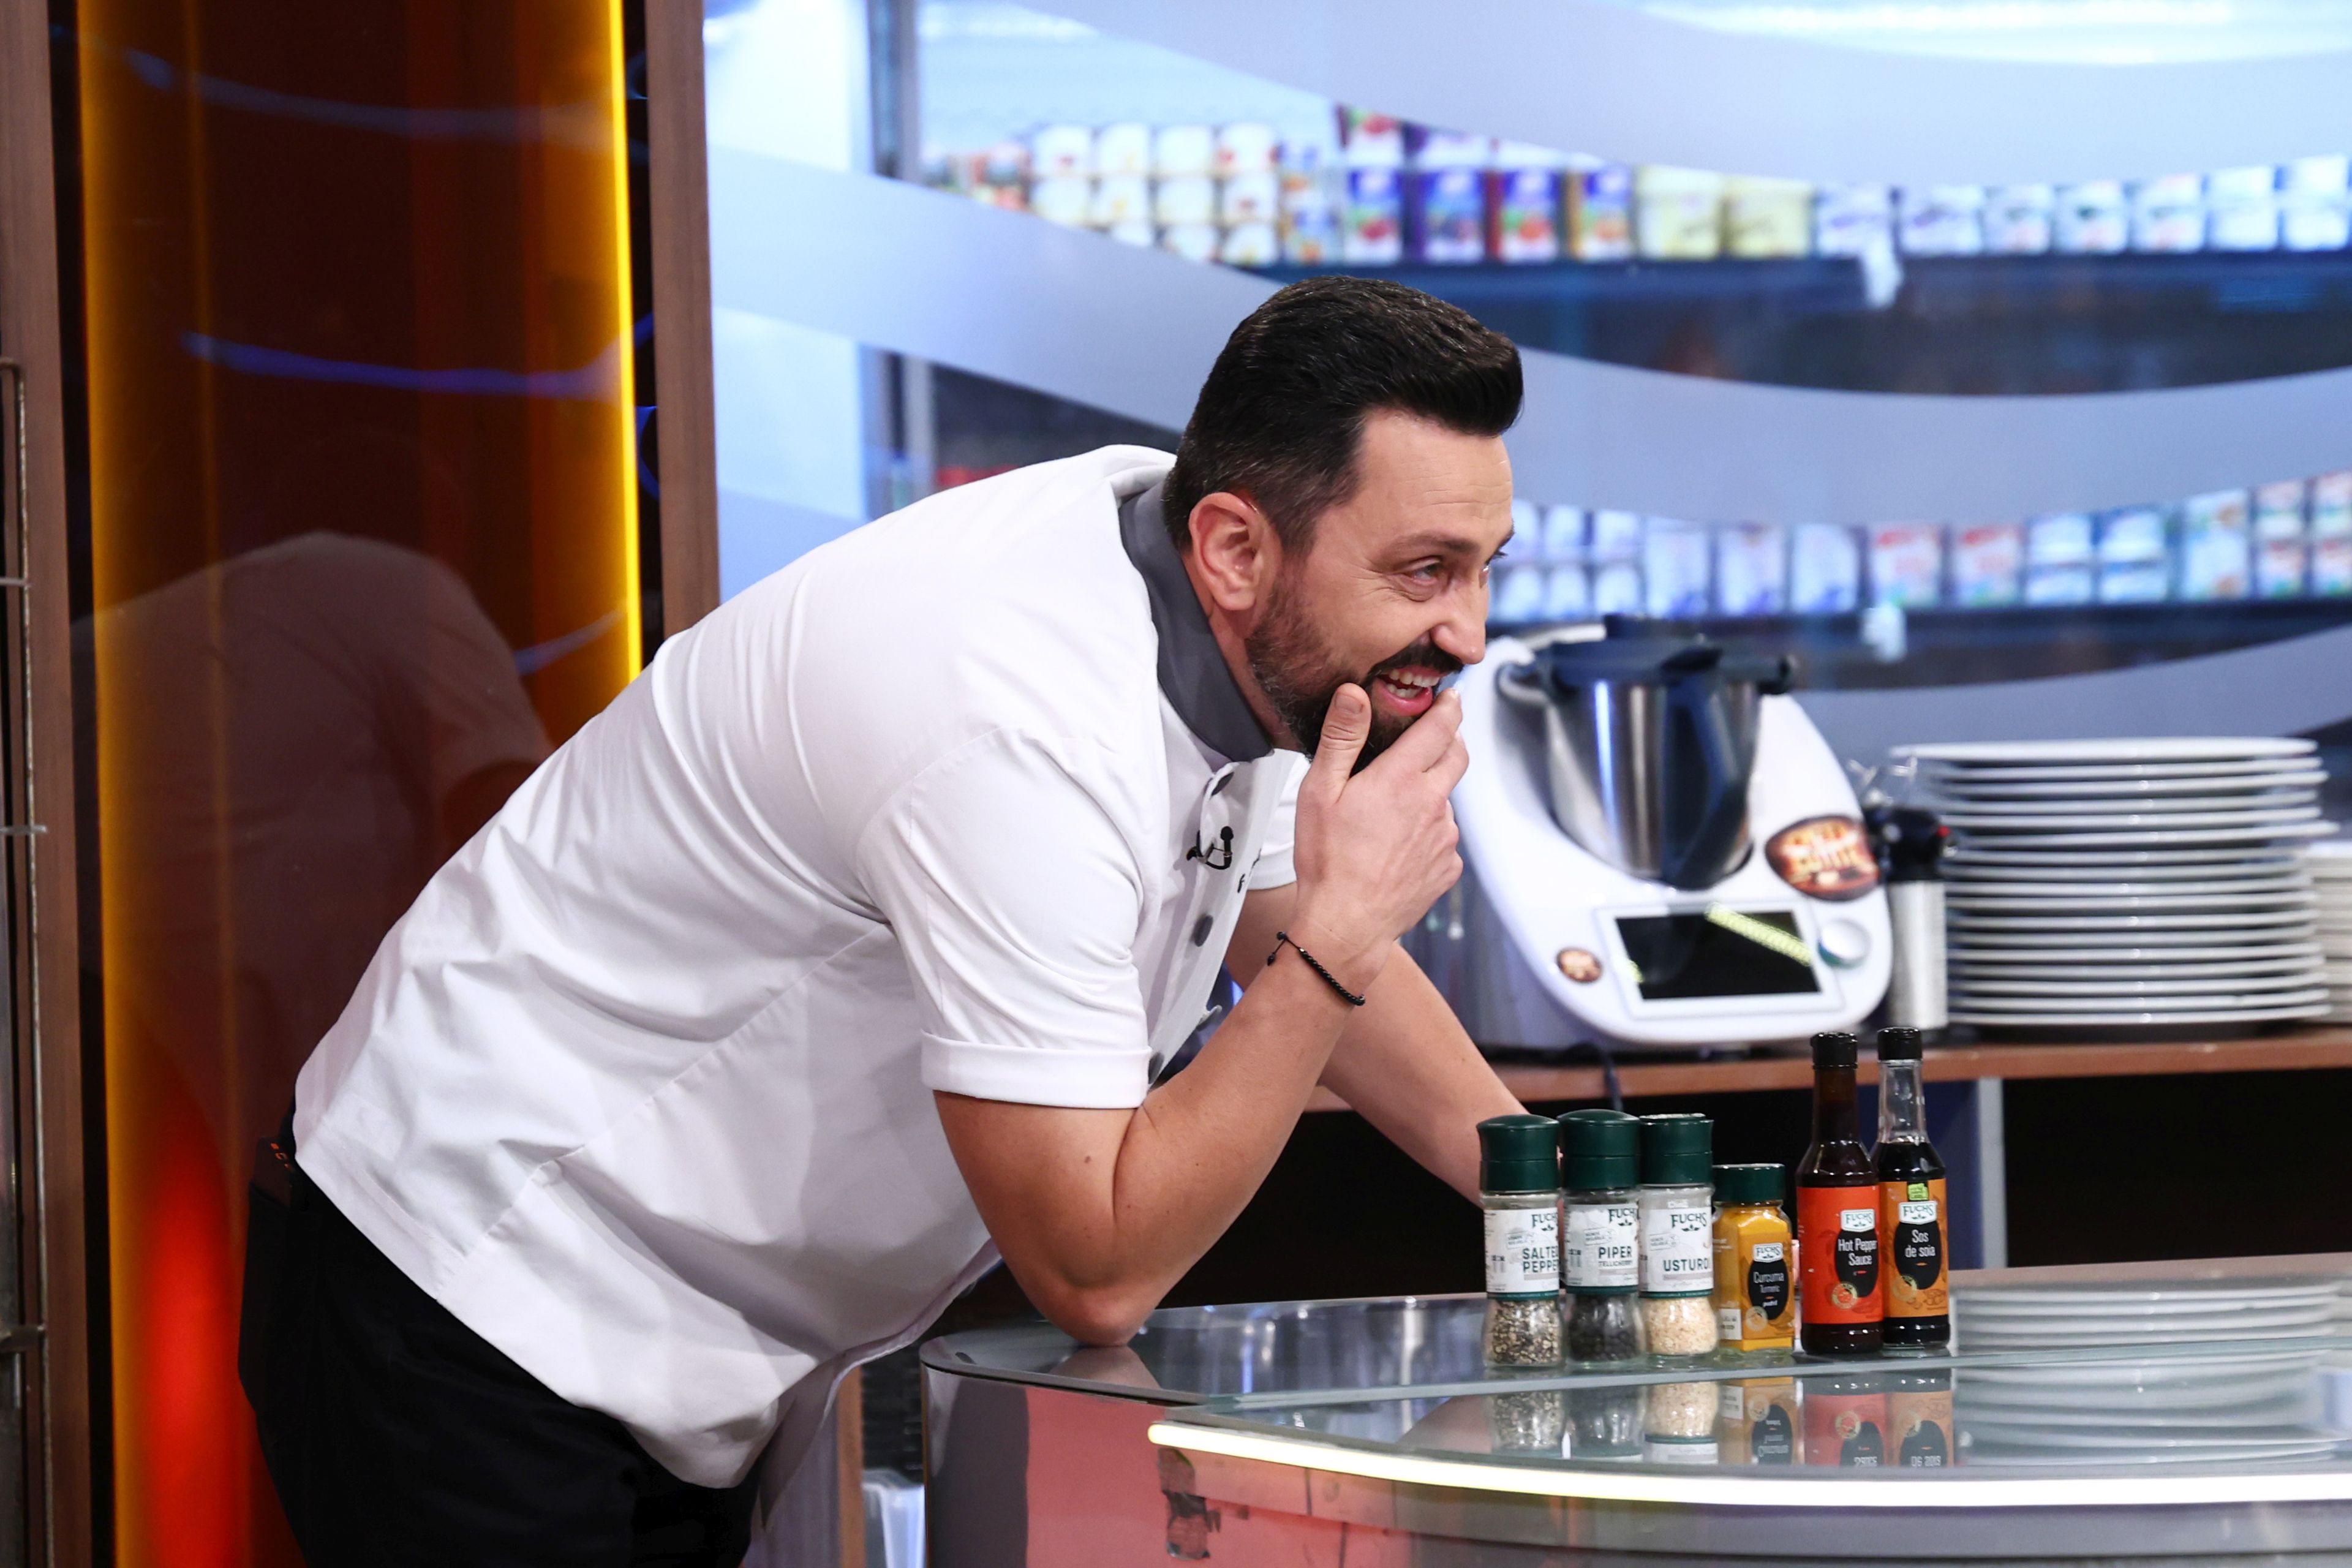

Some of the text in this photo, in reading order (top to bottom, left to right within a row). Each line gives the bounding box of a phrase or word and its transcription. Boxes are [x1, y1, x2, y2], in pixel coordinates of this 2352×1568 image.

[1608, 1208, 1637, 1223] FUCH
[1902, 1204, 1934, 1216] FUCHS
[1531, 1213, 1558, 1228] FUCH
[1670, 1212, 1708, 1228] FUCHS
[1845, 1213, 1873, 1224] FUCHS
[1912, 1229, 1929, 1243] Sos
[1755, 1246, 1782, 1256] FUCHS
[1838, 1238, 1853, 1251] Hot
[1904, 1244, 1936, 1257] de soia
[1522, 1246, 1558, 1259] SALTE
[1598, 1246, 1632, 1259] PIPER
[1522, 1259, 1558, 1273] PEPPE
[1849, 1253, 1872, 1266] Sauce
